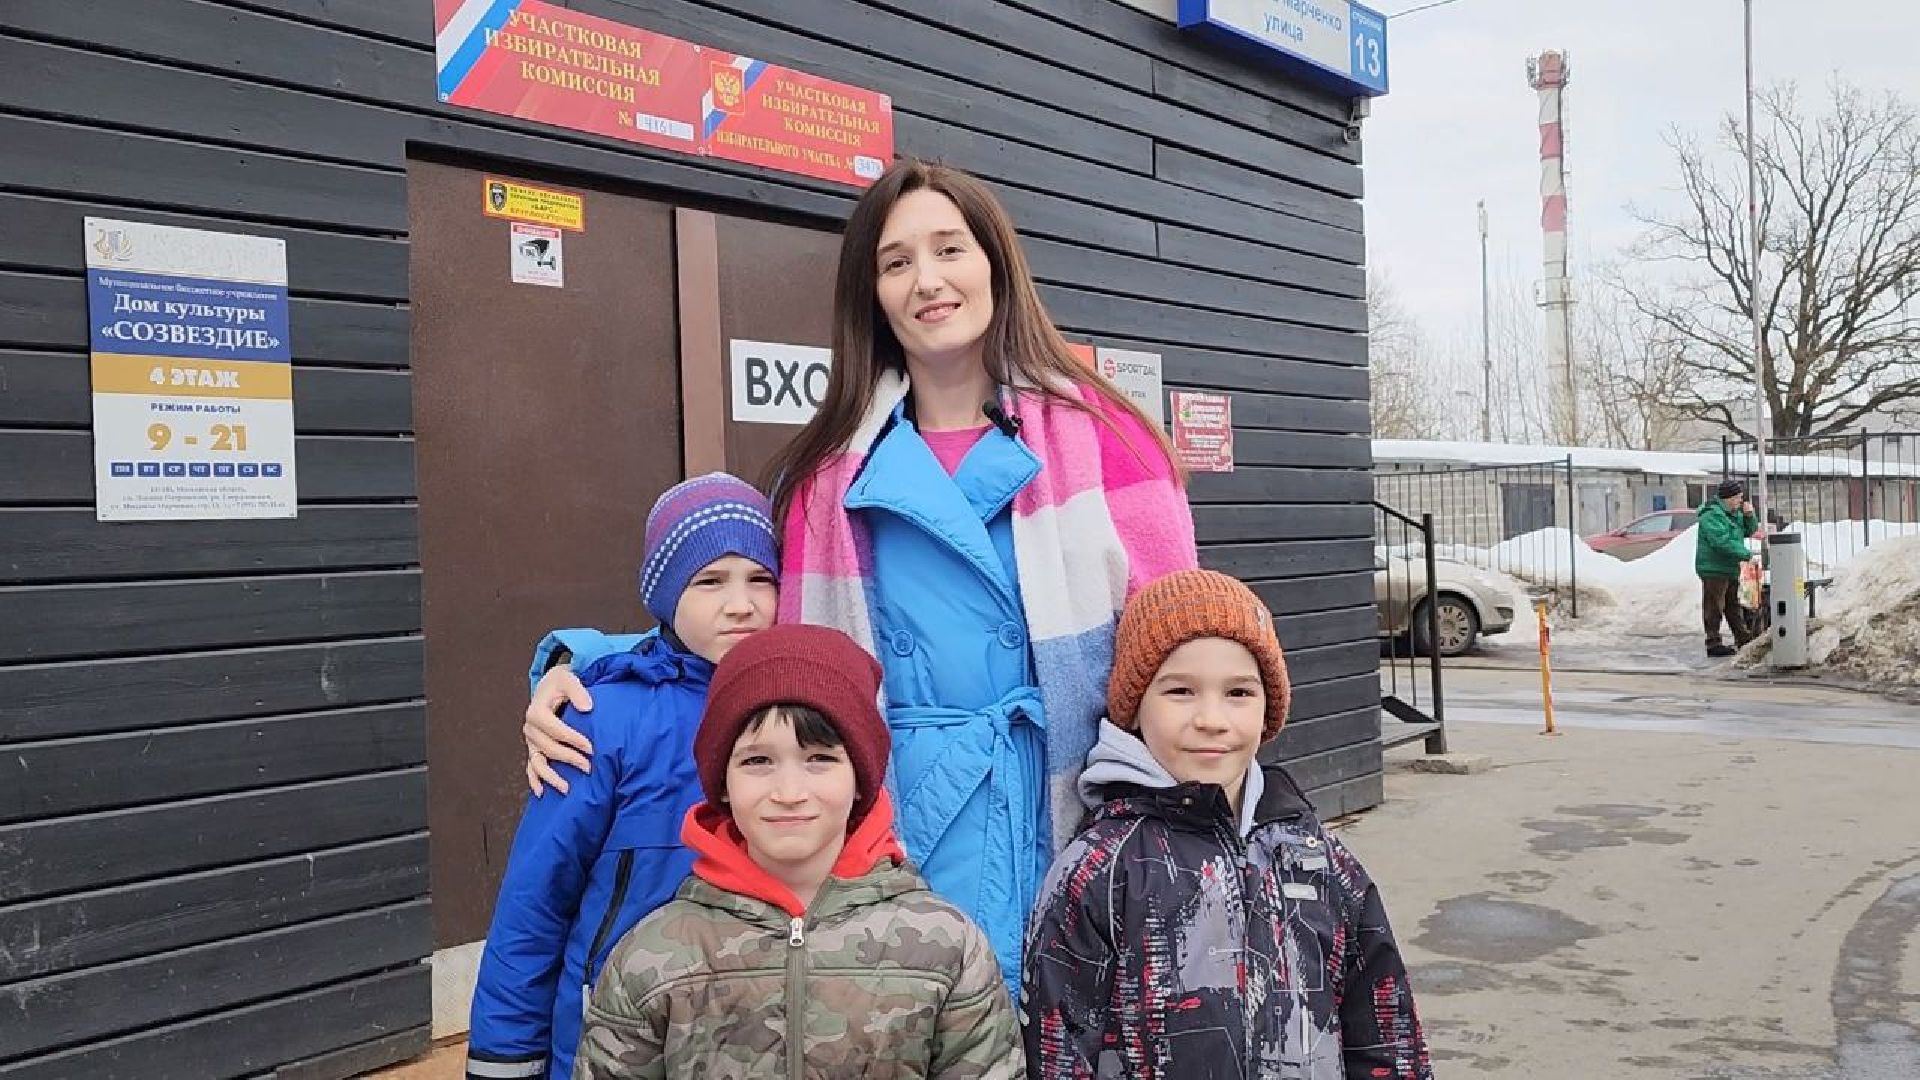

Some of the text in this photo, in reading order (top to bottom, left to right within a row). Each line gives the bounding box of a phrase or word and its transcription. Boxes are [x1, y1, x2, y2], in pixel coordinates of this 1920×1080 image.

[508, 9, 642, 59] УЧАСТКОВАЯ
[1263, 13, 1303, 41] улица
[484, 27, 661, 86] ИЗБИРАТЕЛЬНАЯ
[1355, 33, 1381, 77] 13
[521, 60, 635, 103] КОМИССИЯ
[776, 79, 866, 115] УЧАСТКОВАЯ
[618, 110, 633, 127] №
[762, 93, 880, 134] ИЗБИРАТЕЛЬНАЯ
[716, 130, 799, 159] ИЗБИРАТЕЛЬНОГО
[784, 117, 862, 146] КОМИССИЯ
[114, 293, 265, 324] Дом культуры
[101, 320, 280, 351] «СОЗВЕЗДИЕ»
[149, 367, 241, 388] 4 ЭТАЖ
[745, 357, 830, 409] ВХО
[150, 402, 241, 413] РЕЖИМ РАБОТЫ
[147, 422, 172, 451] 9
[210, 423, 247, 451] 21
